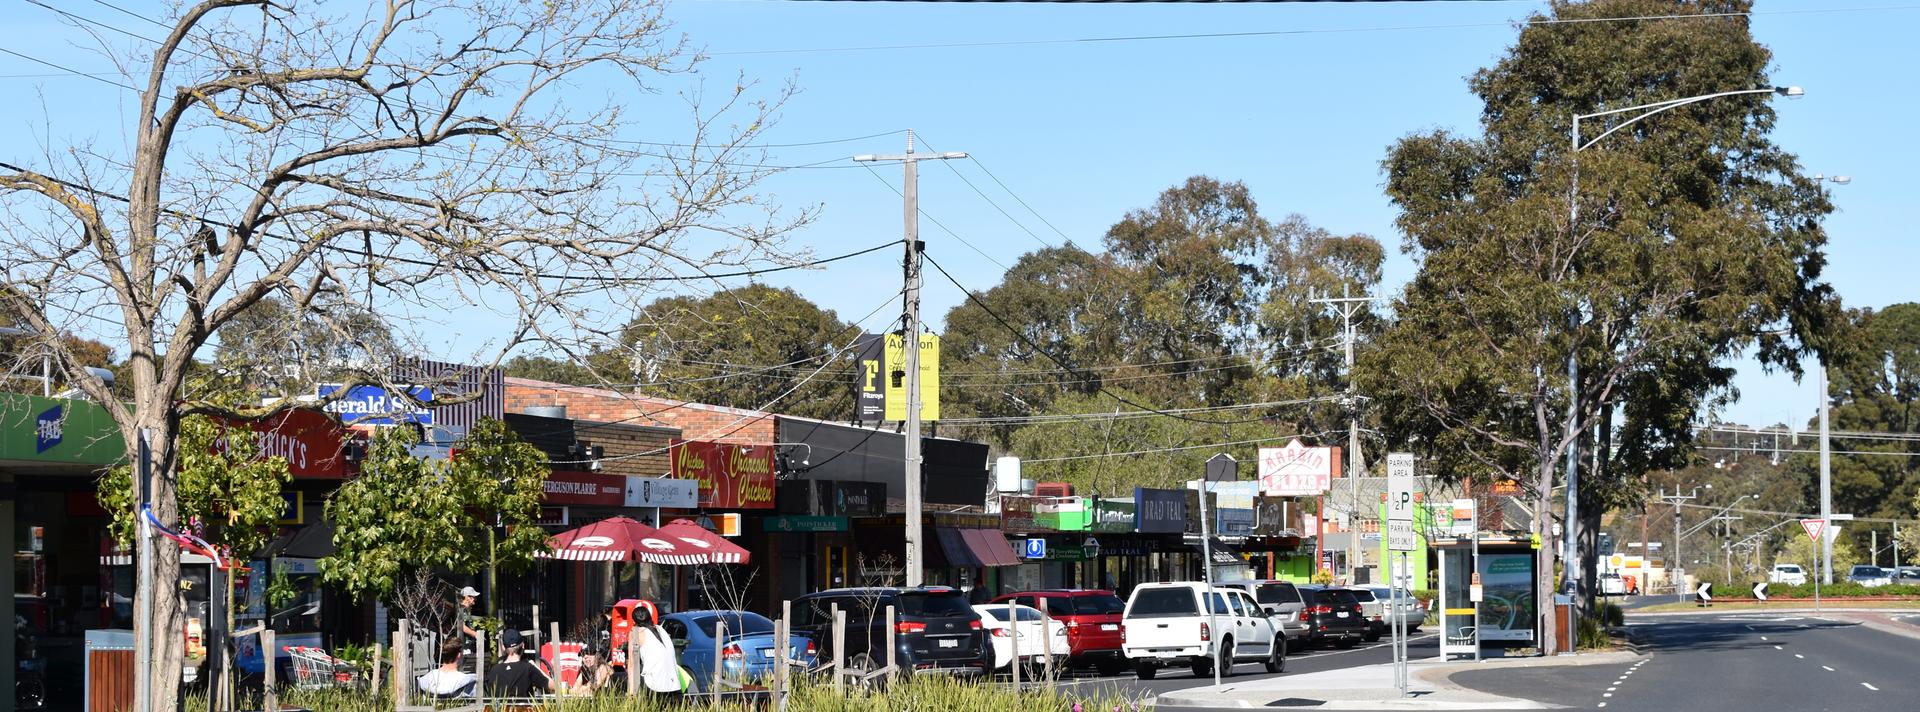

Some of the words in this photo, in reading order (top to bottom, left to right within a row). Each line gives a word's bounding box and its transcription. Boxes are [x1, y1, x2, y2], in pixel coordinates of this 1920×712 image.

[889, 338, 933, 349] Auon
[391, 395, 430, 415] Sn
[39, 420, 60, 439] TAB
[729, 445, 771, 478] Charcoal
[1394, 469, 1408, 477] AREA
[544, 481, 573, 494] FERGUSON
[574, 483, 597, 496] PLARRE
[737, 473, 772, 506] Chicken
[1145, 500, 1164, 520] BRAD
[1166, 501, 1182, 520] TEAL
[1390, 524, 1404, 532] PARK
